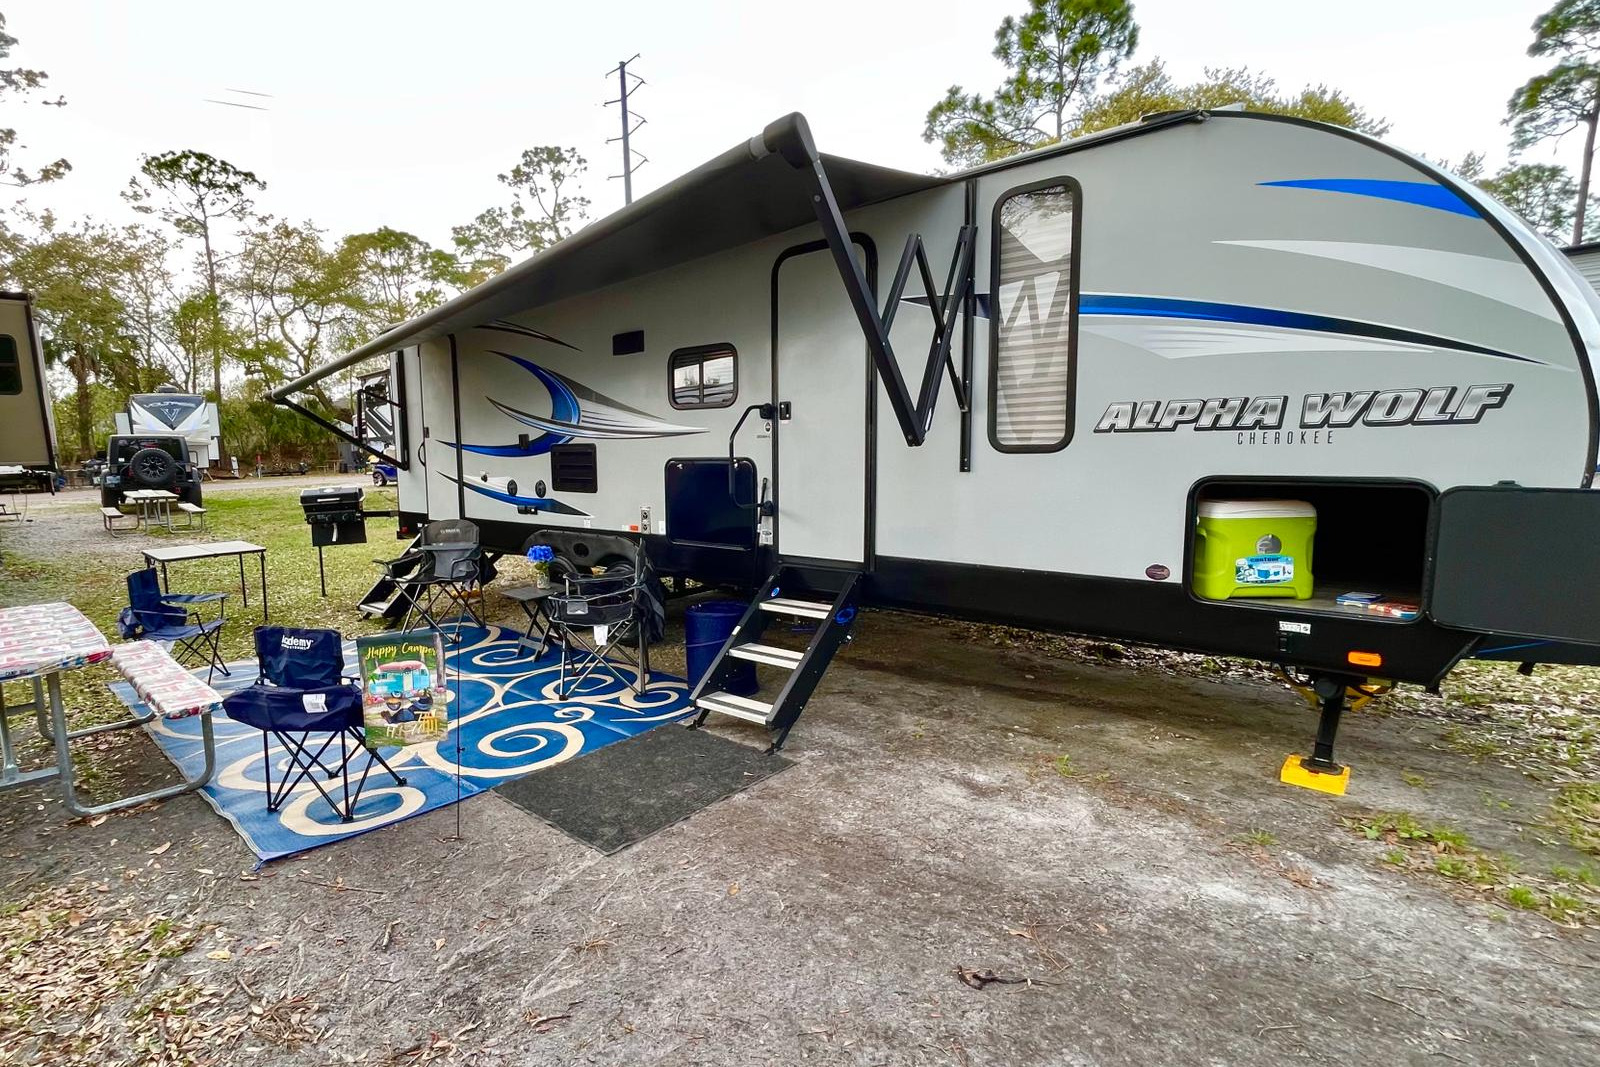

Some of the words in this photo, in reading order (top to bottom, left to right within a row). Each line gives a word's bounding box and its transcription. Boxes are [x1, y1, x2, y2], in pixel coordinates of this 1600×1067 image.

[1093, 395, 1288, 433] ALPHA
[1300, 383, 1514, 429] WOLF
[1237, 430, 1334, 445] CHEROKEE
[364, 645, 397, 660] Happy
[401, 642, 437, 657] Camper
